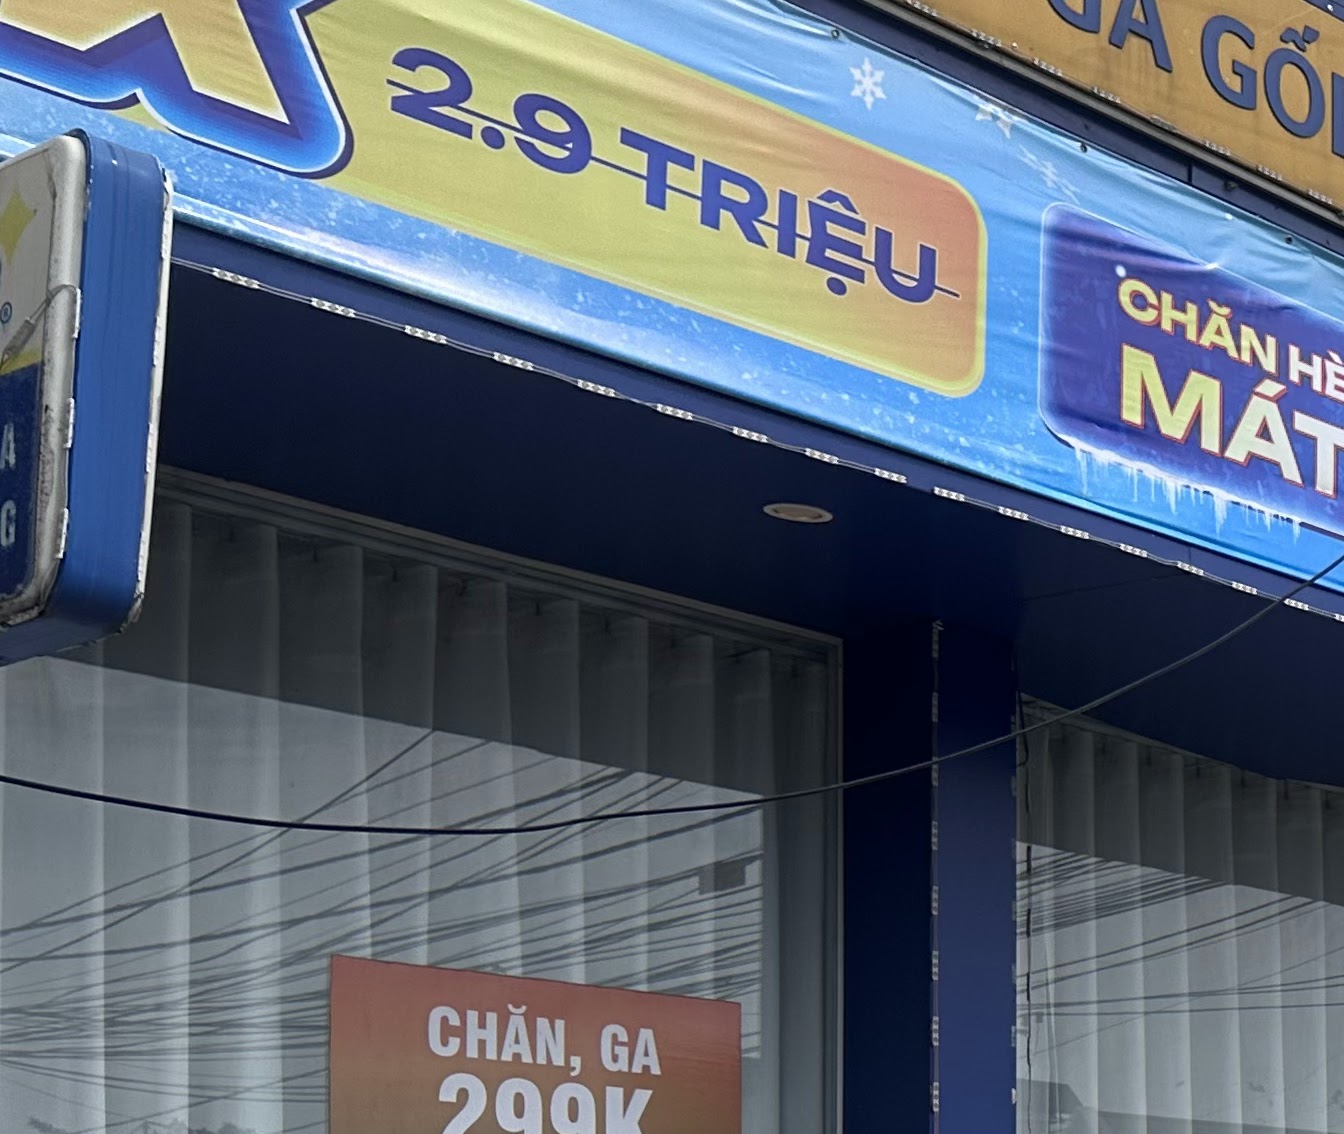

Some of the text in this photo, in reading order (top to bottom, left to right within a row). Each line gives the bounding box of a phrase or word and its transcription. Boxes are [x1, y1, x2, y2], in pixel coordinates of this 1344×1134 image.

[388, 47, 594, 175] 2.9
[620, 128, 940, 306] TRIỆU
[1117, 277, 1279, 375] CHĂN
[427, 1003, 662, 1077] CHĂN, GA
